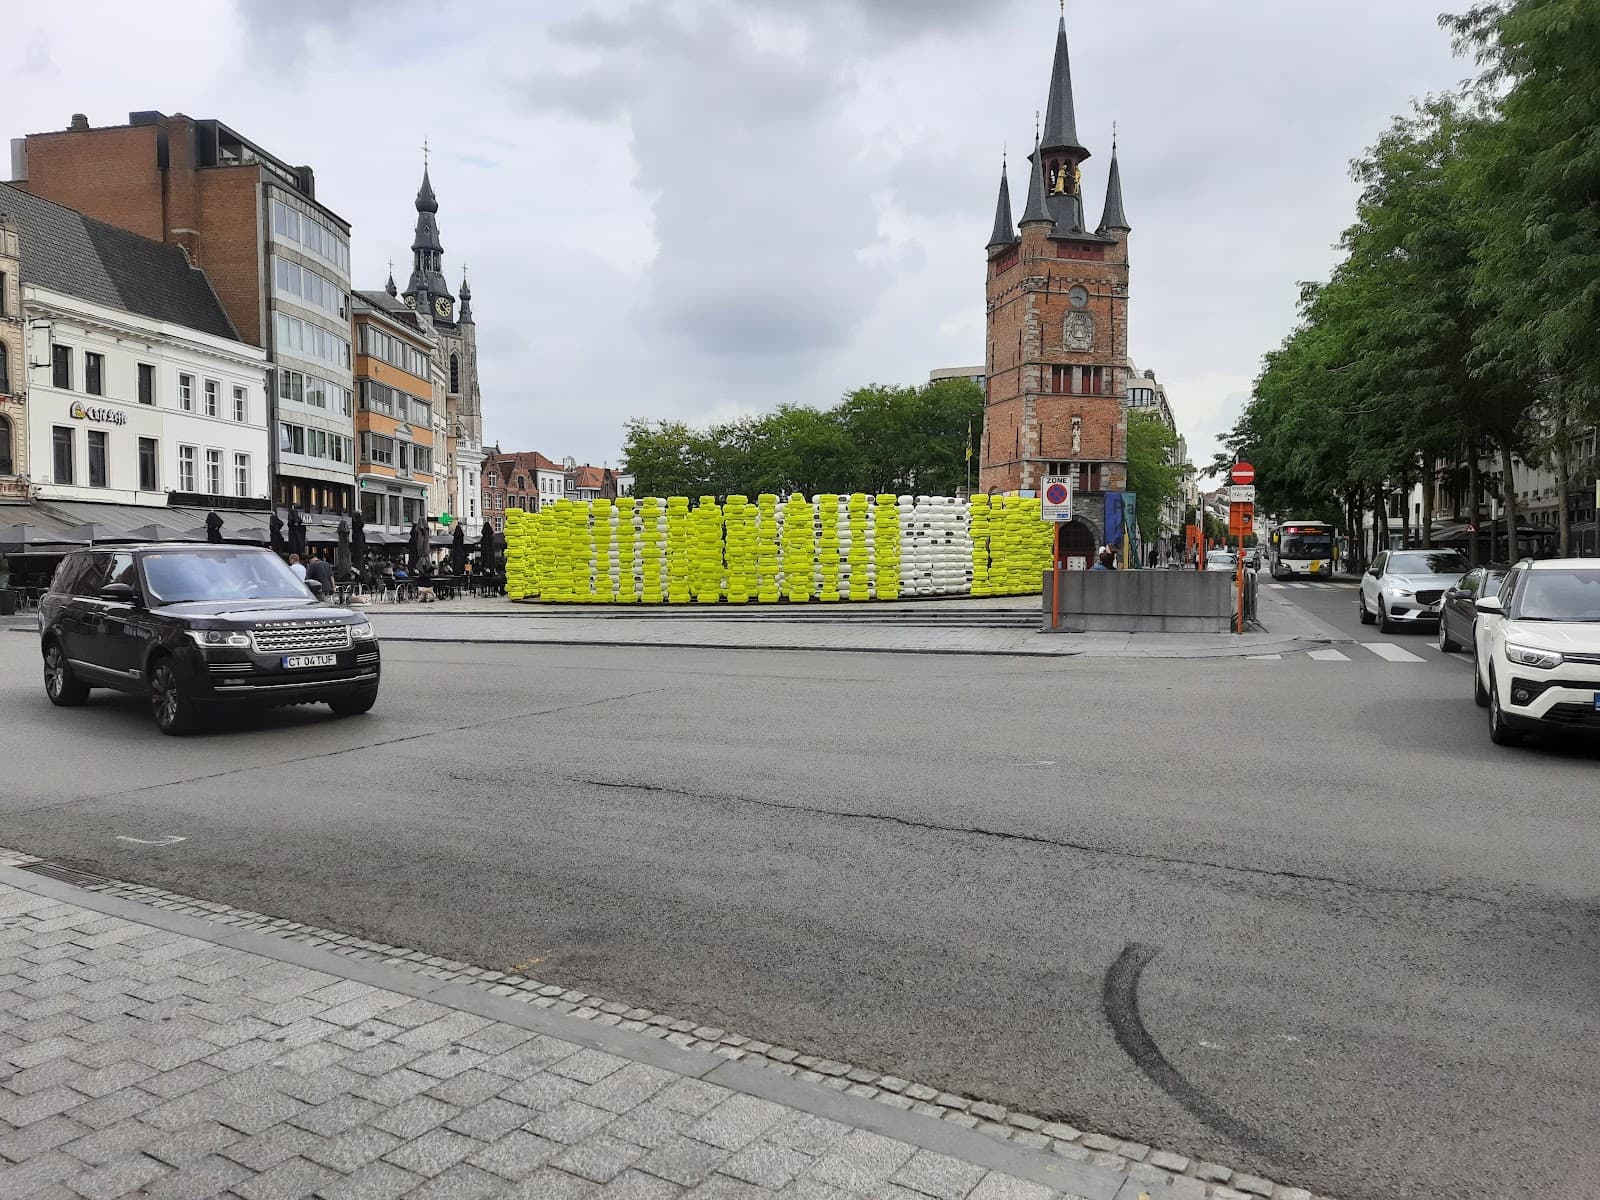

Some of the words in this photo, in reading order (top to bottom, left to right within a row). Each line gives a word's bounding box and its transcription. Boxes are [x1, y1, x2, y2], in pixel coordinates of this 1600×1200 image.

[288, 657, 301, 667] CT
[304, 656, 315, 666] 04
[317, 655, 334, 665] TUF
